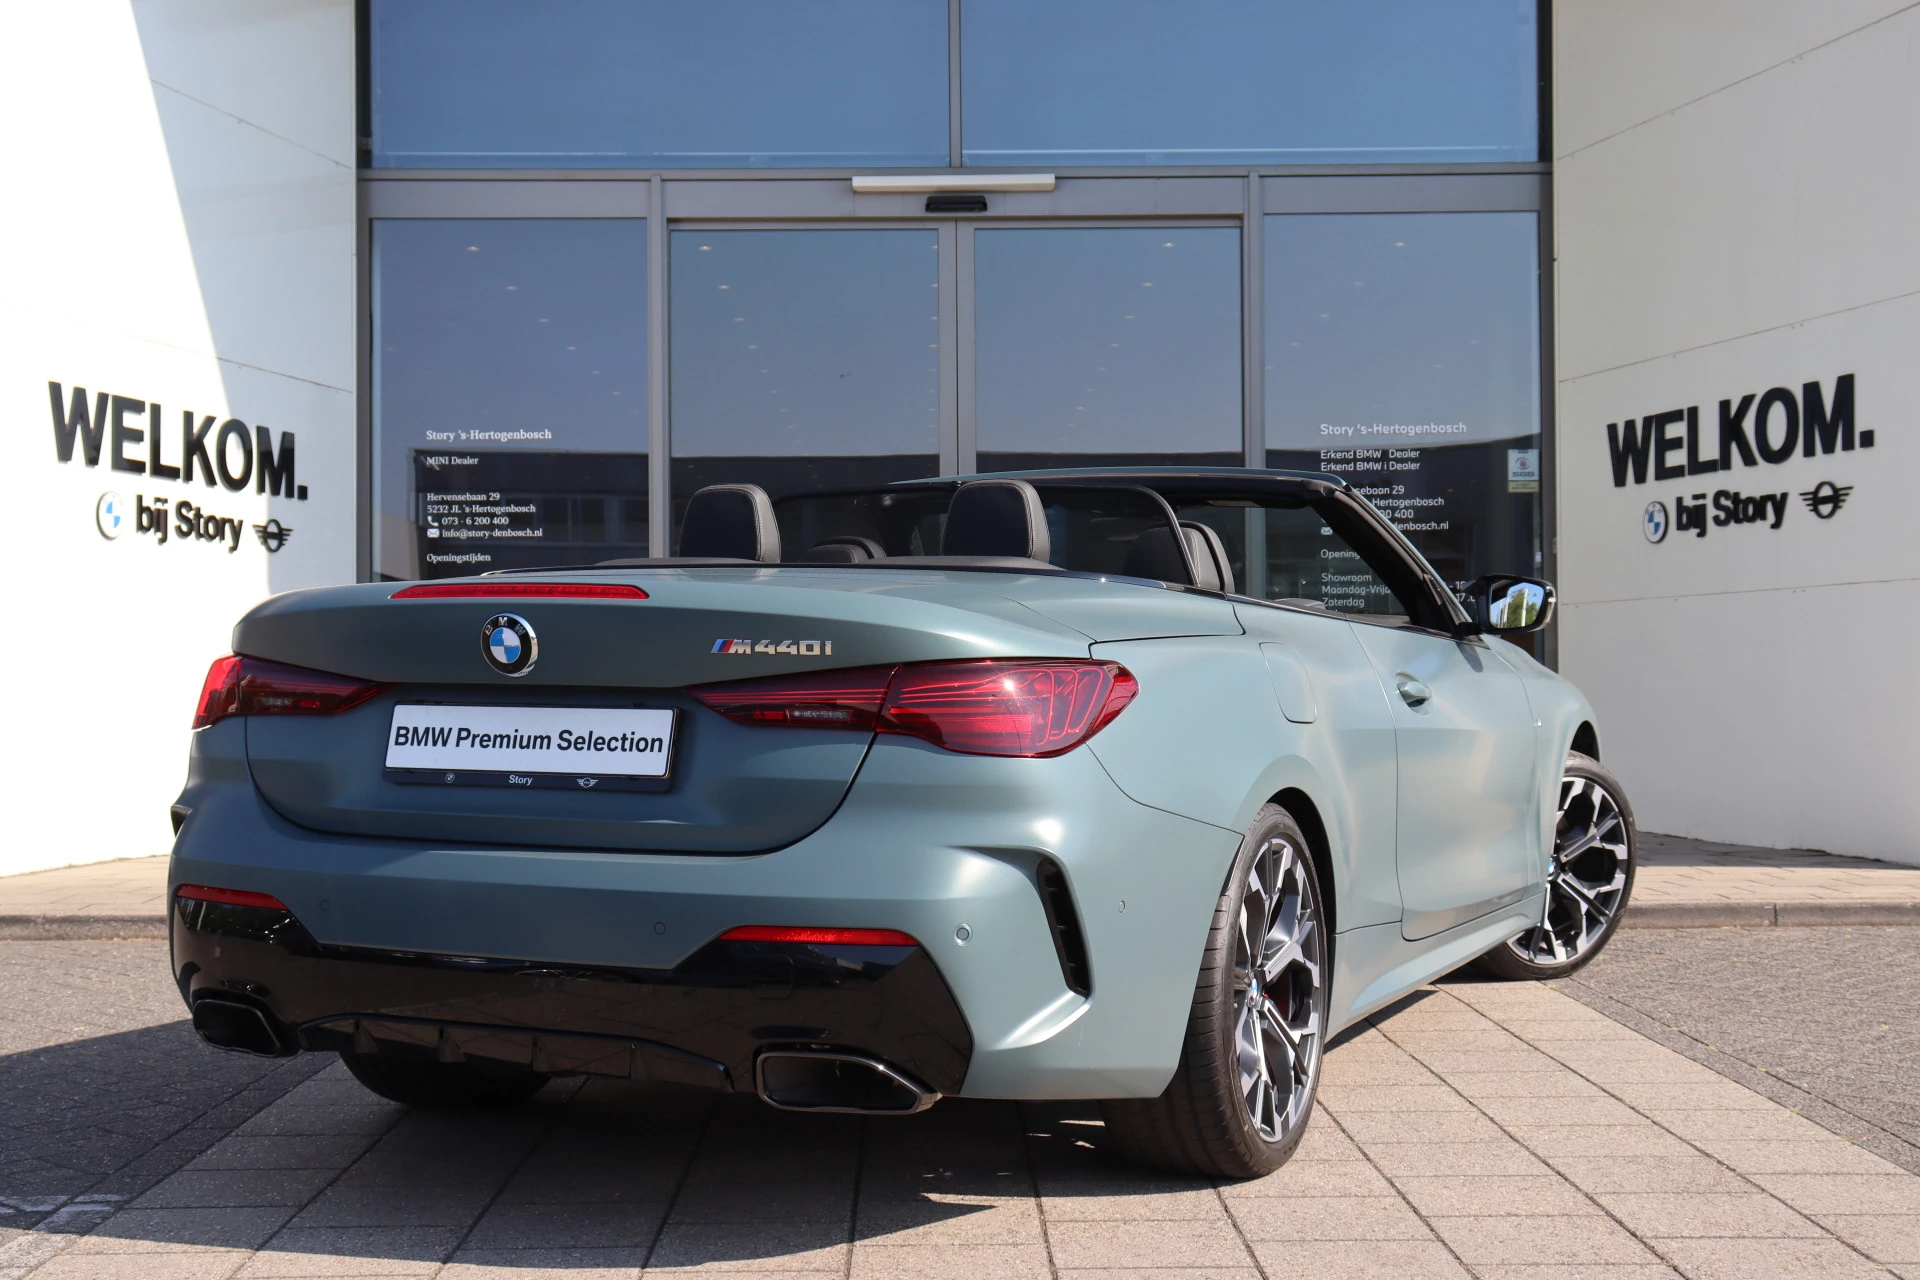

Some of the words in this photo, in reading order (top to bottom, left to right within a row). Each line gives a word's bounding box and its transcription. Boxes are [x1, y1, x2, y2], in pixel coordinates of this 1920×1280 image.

[425, 429, 456, 443] Story
[1320, 423, 1354, 437] Story
[1606, 372, 1875, 488] WELKOM.
[48, 380, 308, 500] WELKOM.
[426, 456, 450, 465] MINI
[451, 456, 479, 465] Dealer
[1320, 449, 1354, 460] Erkend
[1356, 449, 1382, 460] BMW
[1388, 449, 1421, 459] Dealer
[1320, 461, 1354, 472] Erkend
[1356, 461, 1382, 471] BMW
[1383, 461, 1387, 471] i
[1388, 460, 1421, 470] Dealer
[1392, 484, 1405, 495] 29
[426, 492, 487, 502] Hervensebaan
[488, 492, 501, 502] 29
[1372, 496, 1445, 508] Hertogenbosch
[426, 504, 452, 514] 5232
[450, 504, 462, 514] JL
[1394, 508, 1414, 519] 400
[1676, 492, 1708, 538] bij
[1712, 489, 1789, 530] Story
[136, 494, 168, 545] bij
[174, 500, 244, 554] Story
[441, 516, 458, 526] 073
[465, 516, 472, 526] 6
[473, 516, 491, 526] 200
[492, 516, 509, 526] 400
[1392, 520, 1449, 531] denbosch.nl
[442, 528, 543, 540] info@story-denbosch.nl
[426, 553, 492, 564] Openingstijden
[1320, 548, 1360, 560] Opening
[1321, 572, 1372, 582] Showroom
[1322, 597, 1365, 609] Zaterdag
[484, 616, 527, 637] BMW
[728, 638, 832, 656] M440i
[394, 725, 453, 748] BMW
[455, 726, 552, 751] Premium
[556, 729, 664, 754] Selection
[508, 774, 533, 787] Story
